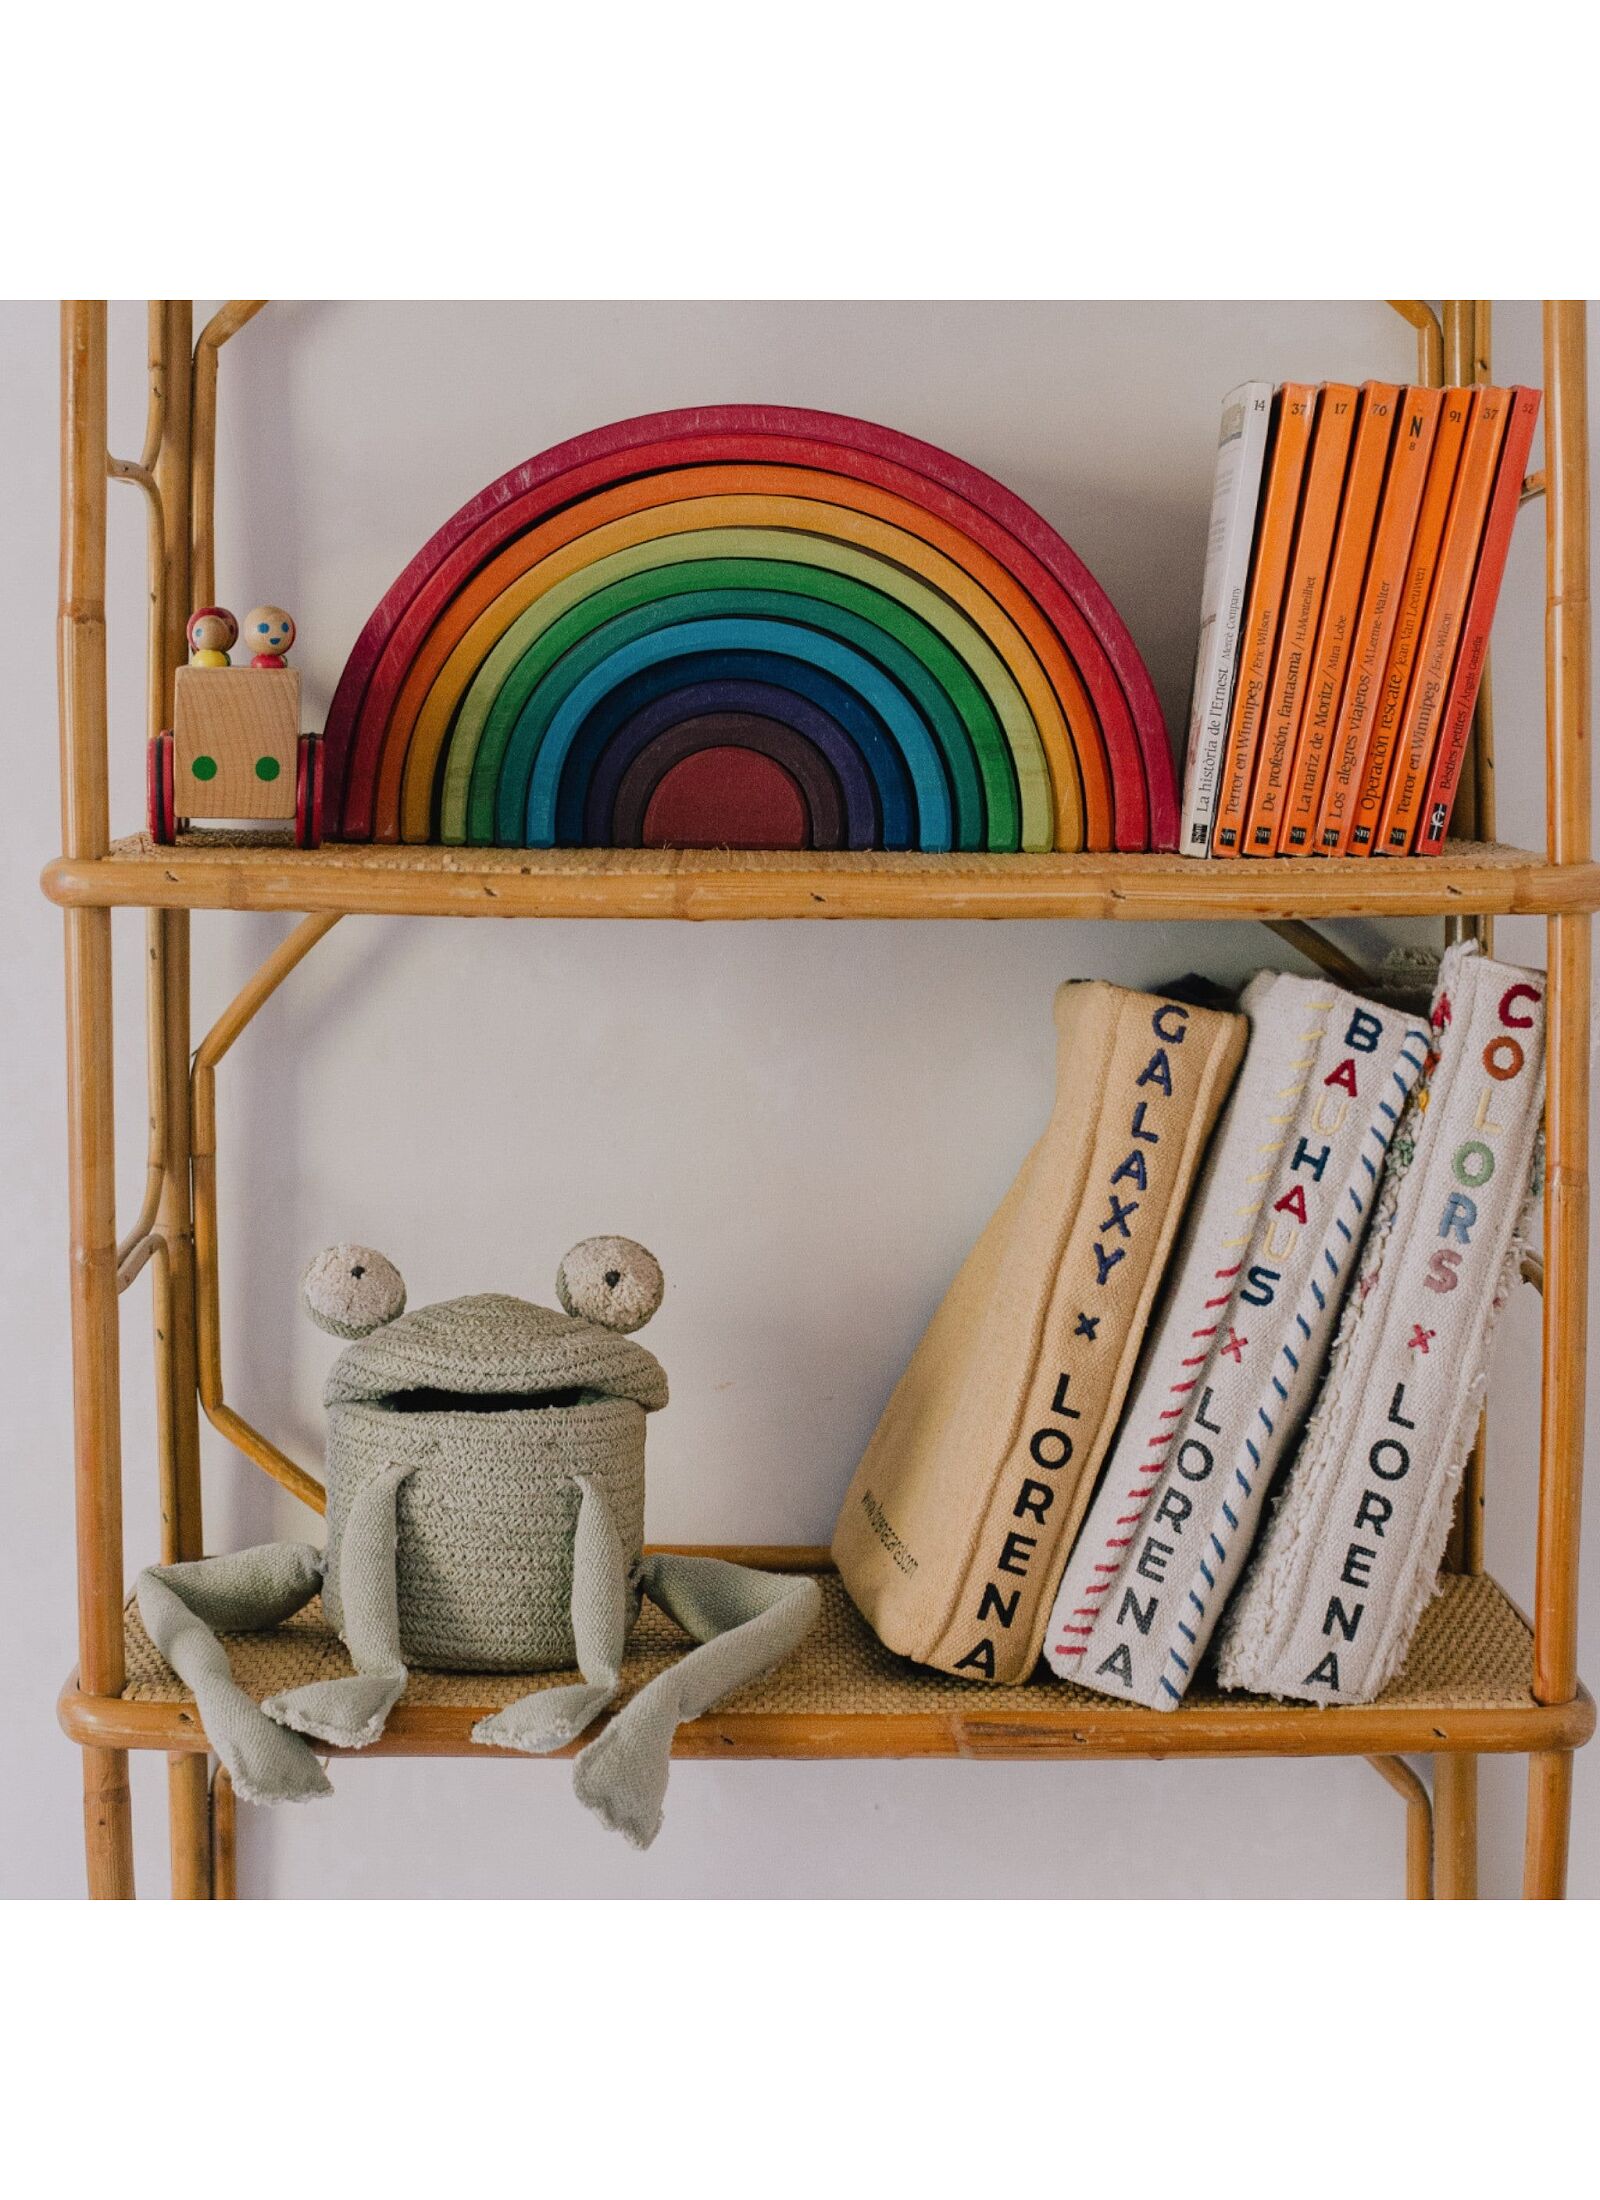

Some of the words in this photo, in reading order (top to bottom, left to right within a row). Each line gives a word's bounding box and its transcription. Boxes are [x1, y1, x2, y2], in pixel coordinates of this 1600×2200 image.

[1253, 399, 1266, 412] 14
[1334, 402, 1348, 415] 17
[1449, 410, 1462, 423] 91
[1482, 407, 1499, 420] 37
[1409, 415, 1423, 439] N
[1256, 609, 1271, 647] Wilson
[1333, 615, 1347, 641] Lobe
[1437, 612, 1453, 648] Wilson
[1327, 645, 1341, 670] Mira
[1196, 796, 1210, 813] La
[1207, 719, 1220, 736] de
[1226, 586, 1242, 630] Company
[1235, 680, 1263, 750] Winnipeg
[1313, 681, 1334, 728] Moritz
[1347, 674, 1371, 731] viajeros
[1360, 735, 1390, 811] Operación
[1381, 674, 1402, 730] rescate
[1400, 620, 1415, 641] Van
[1410, 681, 1440, 750] Winnipeg
[1261, 792, 1277, 812] De
[1277, 651, 1303, 718] fantasma
[1309, 732, 1325, 750] de
[1451, 710, 1466, 749] petites
[1235, 752, 1248, 770] en
[1303, 753, 1320, 791] nariz
[1336, 734, 1358, 785] alegres
[1408, 752, 1422, 770] en
[1224, 773, 1244, 815] Terror
[1296, 795, 1312, 813] La
[1328, 791, 1346, 819] Los
[1396, 774, 1417, 815] Terror
[1092, 1004, 1190, 1286] GALAXY
[1240, 1007, 1385, 1308] BAUHAUS
[1425, 983, 1542, 1294] COLORS
[953, 1373, 1080, 1679] LORENA
[1099, 1385, 1221, 1689] LORENA
[1304, 1383, 1416, 1692] LORENA
